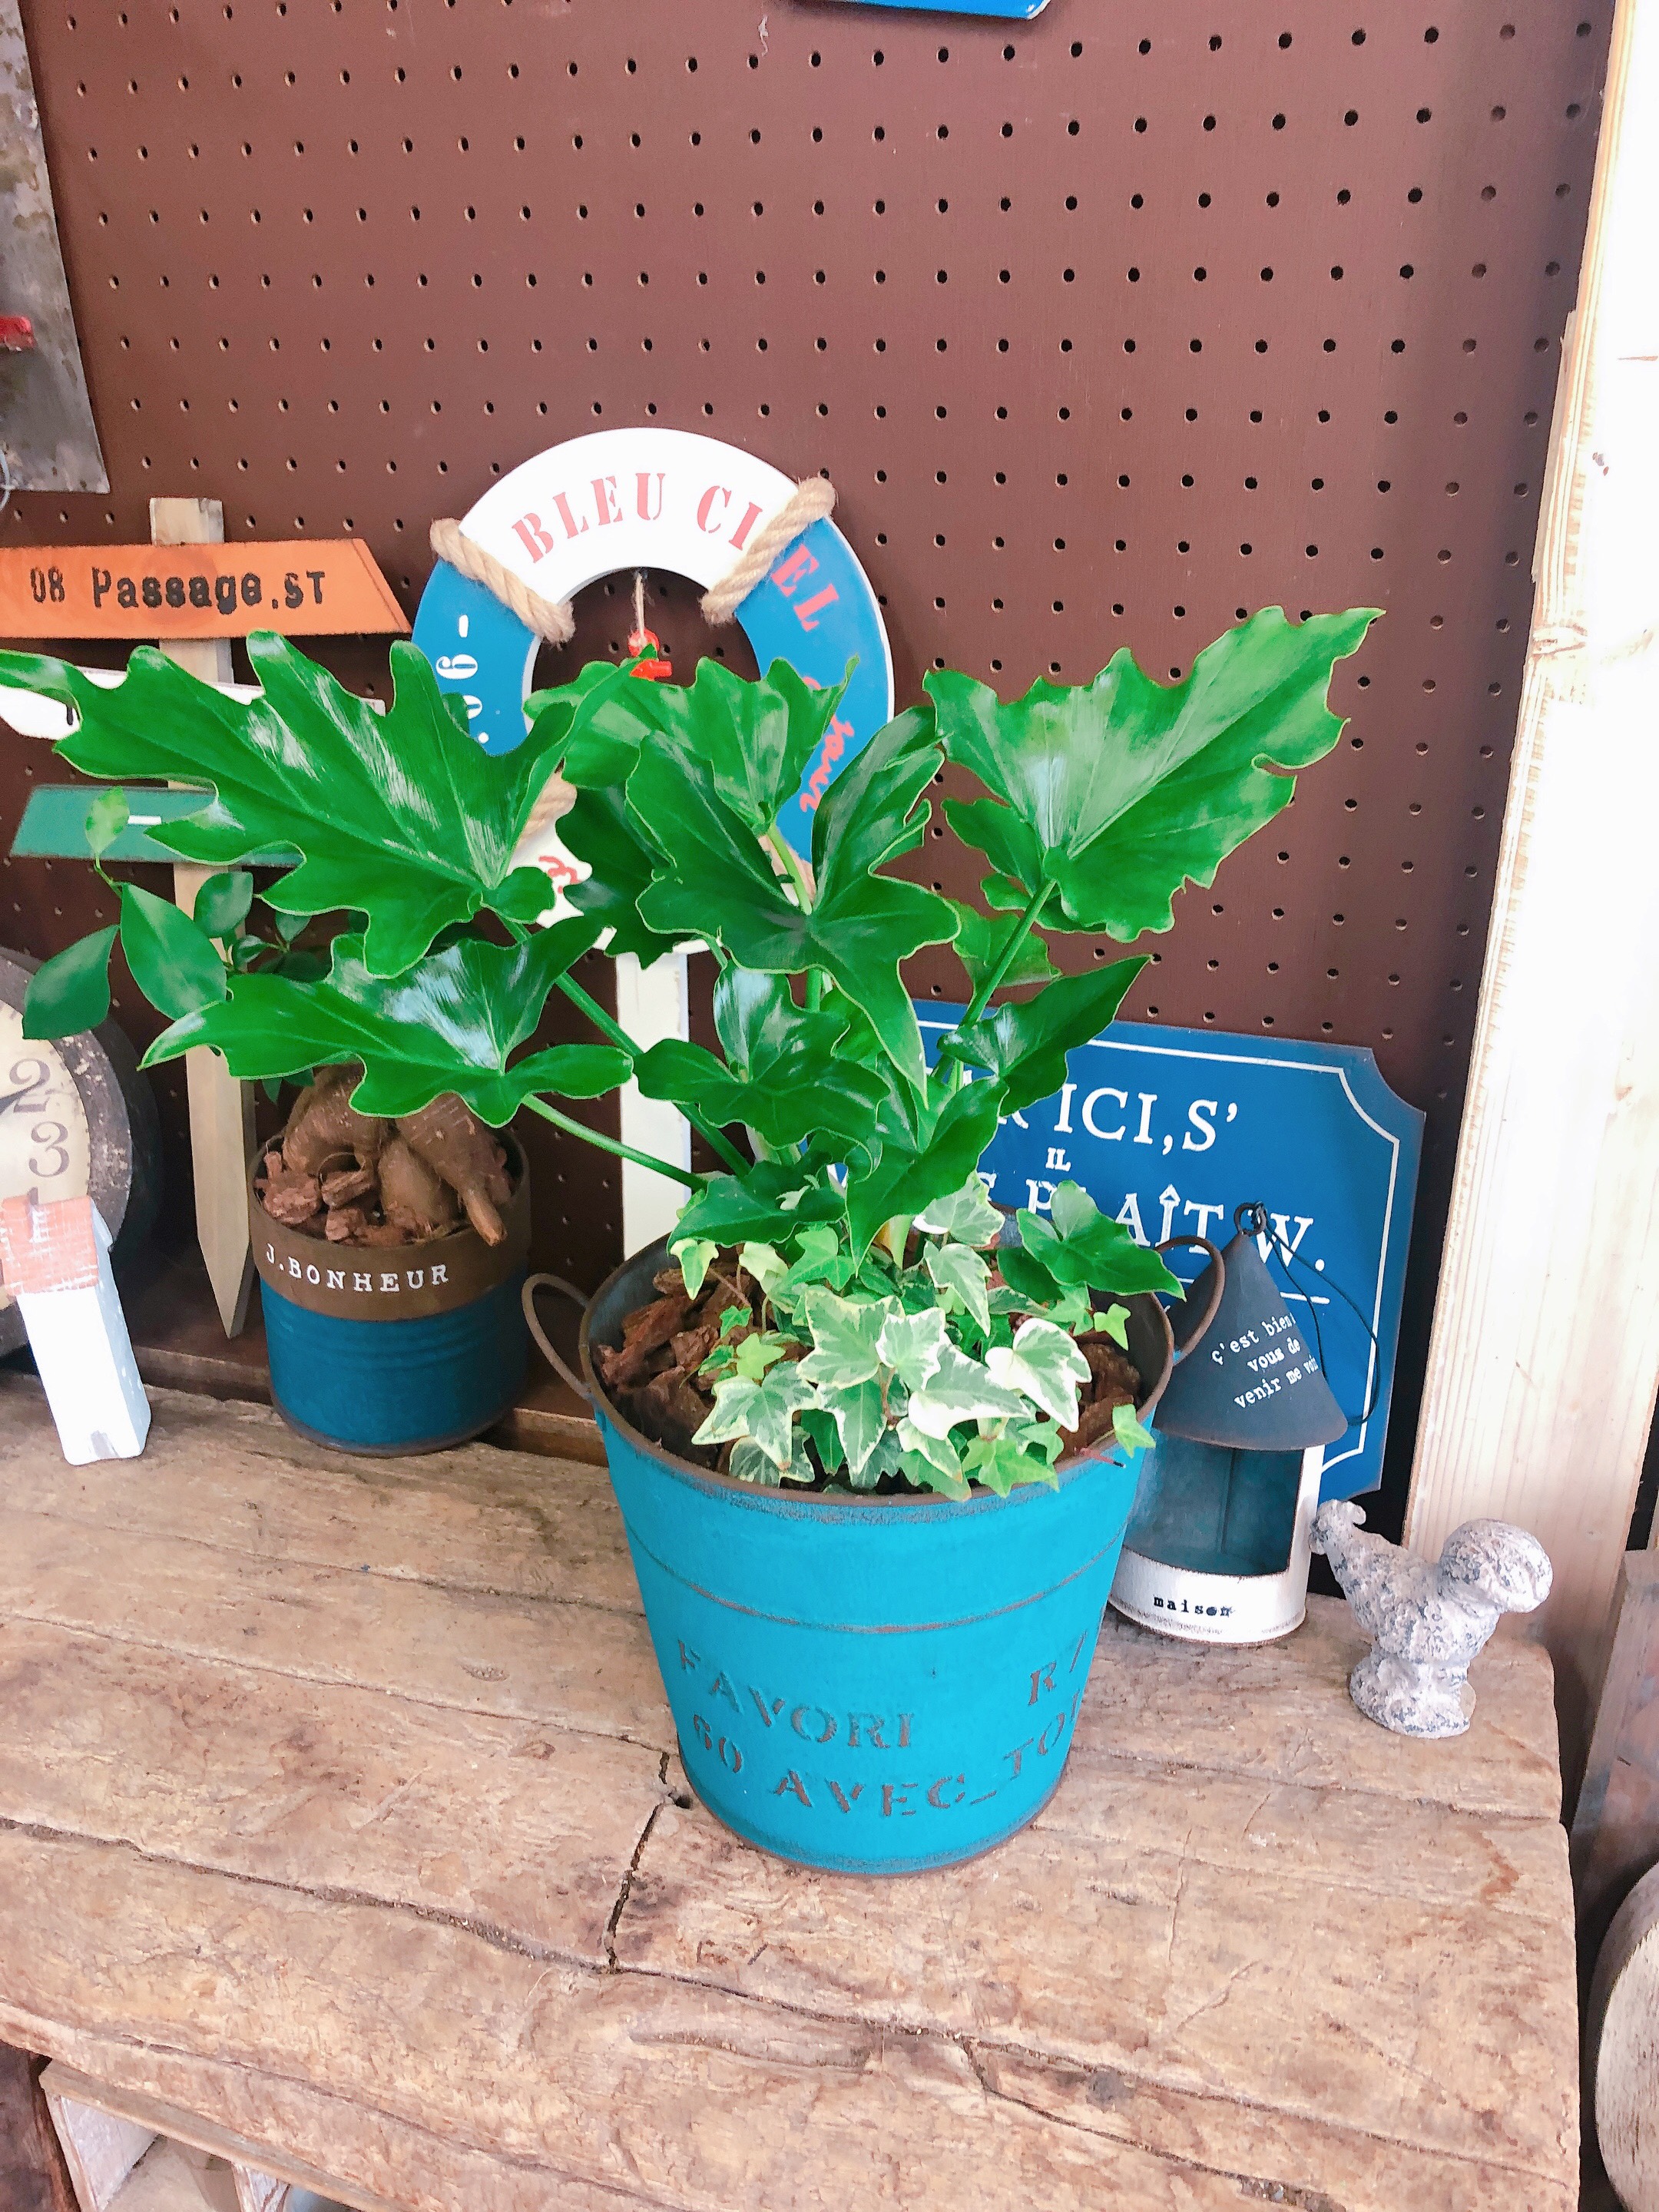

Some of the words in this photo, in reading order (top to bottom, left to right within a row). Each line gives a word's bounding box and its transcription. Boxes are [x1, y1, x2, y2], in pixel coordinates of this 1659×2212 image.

[512, 472, 665, 564] BLEU
[697, 485, 839, 633] CIEL
[30, 565, 65, 604] 08
[9, 1058, 51, 1113] 2
[28, 1121, 70, 1177] 3
[1045, 1146, 1071, 1172] IL
[266, 1242, 449, 1293] J.BONHEUR
[1247, 1346, 1285, 1373] vous
[1286, 1336, 1301, 1355] de
[1233, 1377, 1283, 1409] venir
[1285, 1366, 1303, 1385] me
[1153, 1596, 1234, 1618] maison
[677, 1637, 916, 1749] FAVORI
